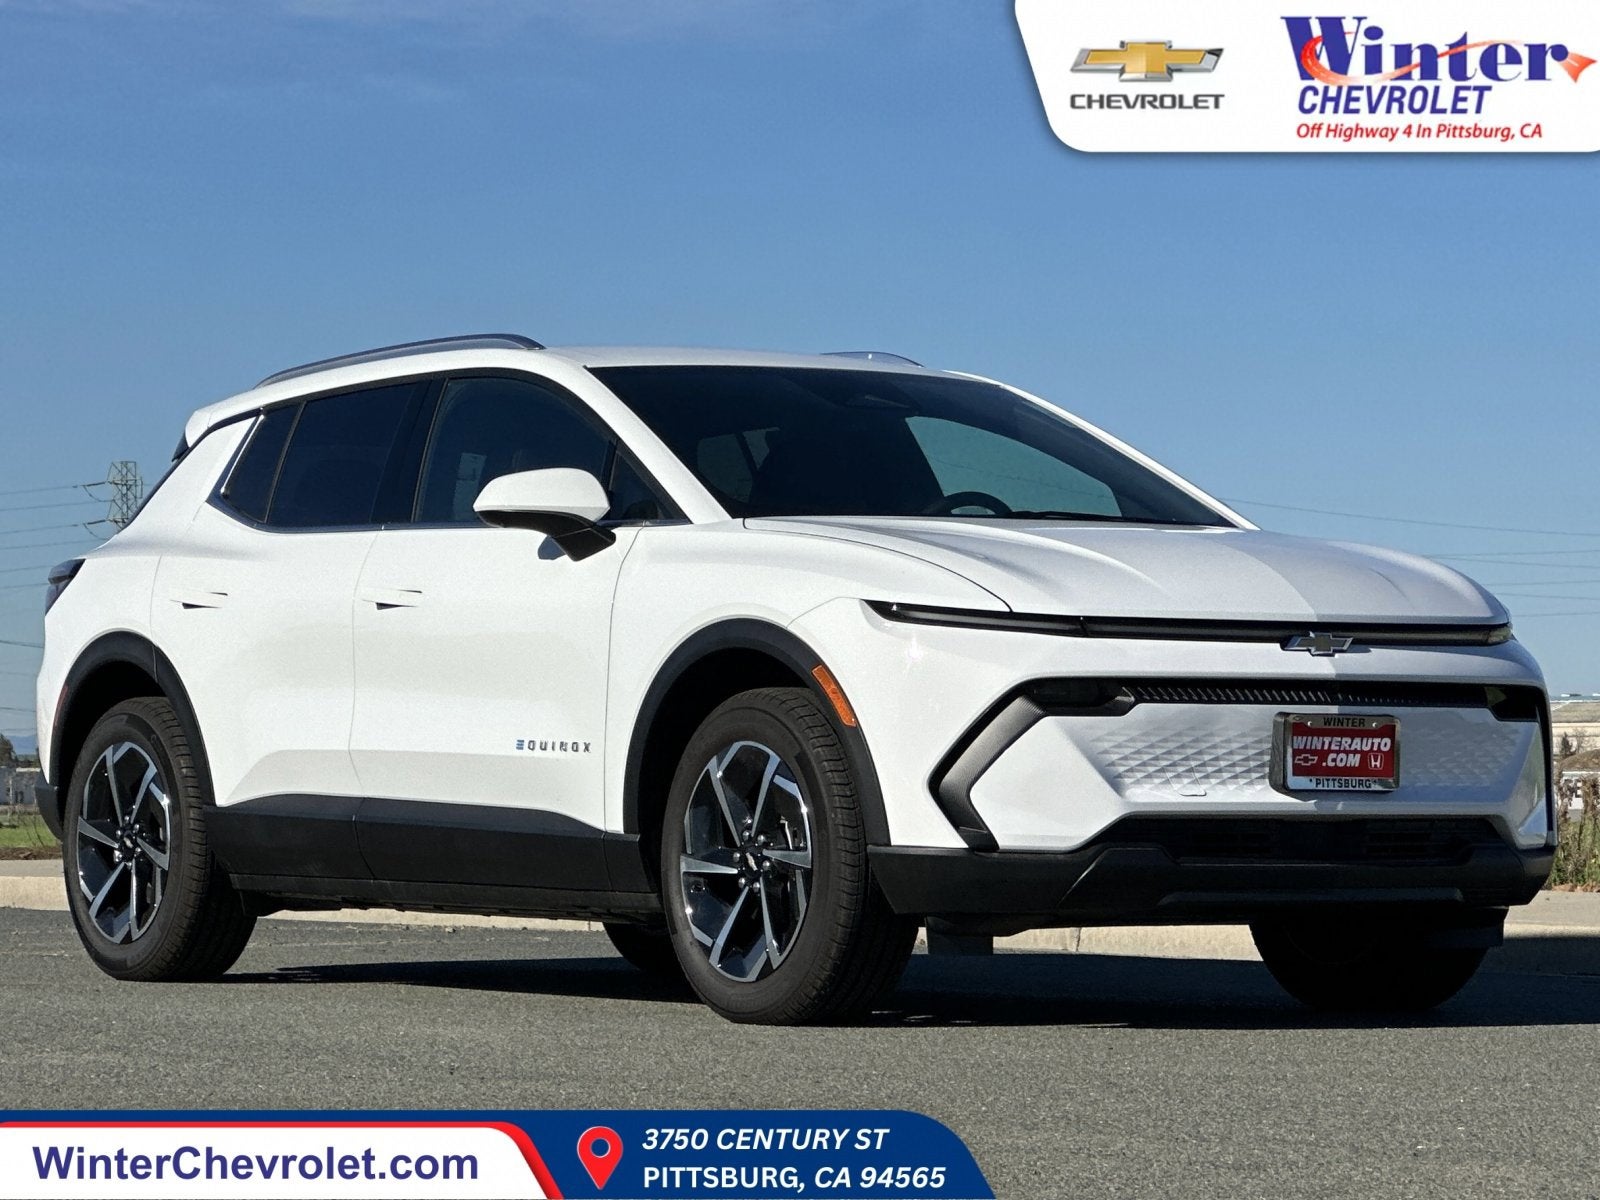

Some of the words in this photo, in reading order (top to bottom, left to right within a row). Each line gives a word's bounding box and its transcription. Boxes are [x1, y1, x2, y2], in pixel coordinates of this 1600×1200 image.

[1323, 718, 1366, 727] WINTER
[516, 739, 592, 753] EQUINOX
[1292, 736, 1392, 752] WINTERAUTO
[1321, 753, 1361, 768] .COM
[1315, 778, 1372, 789] PITTSBURG
